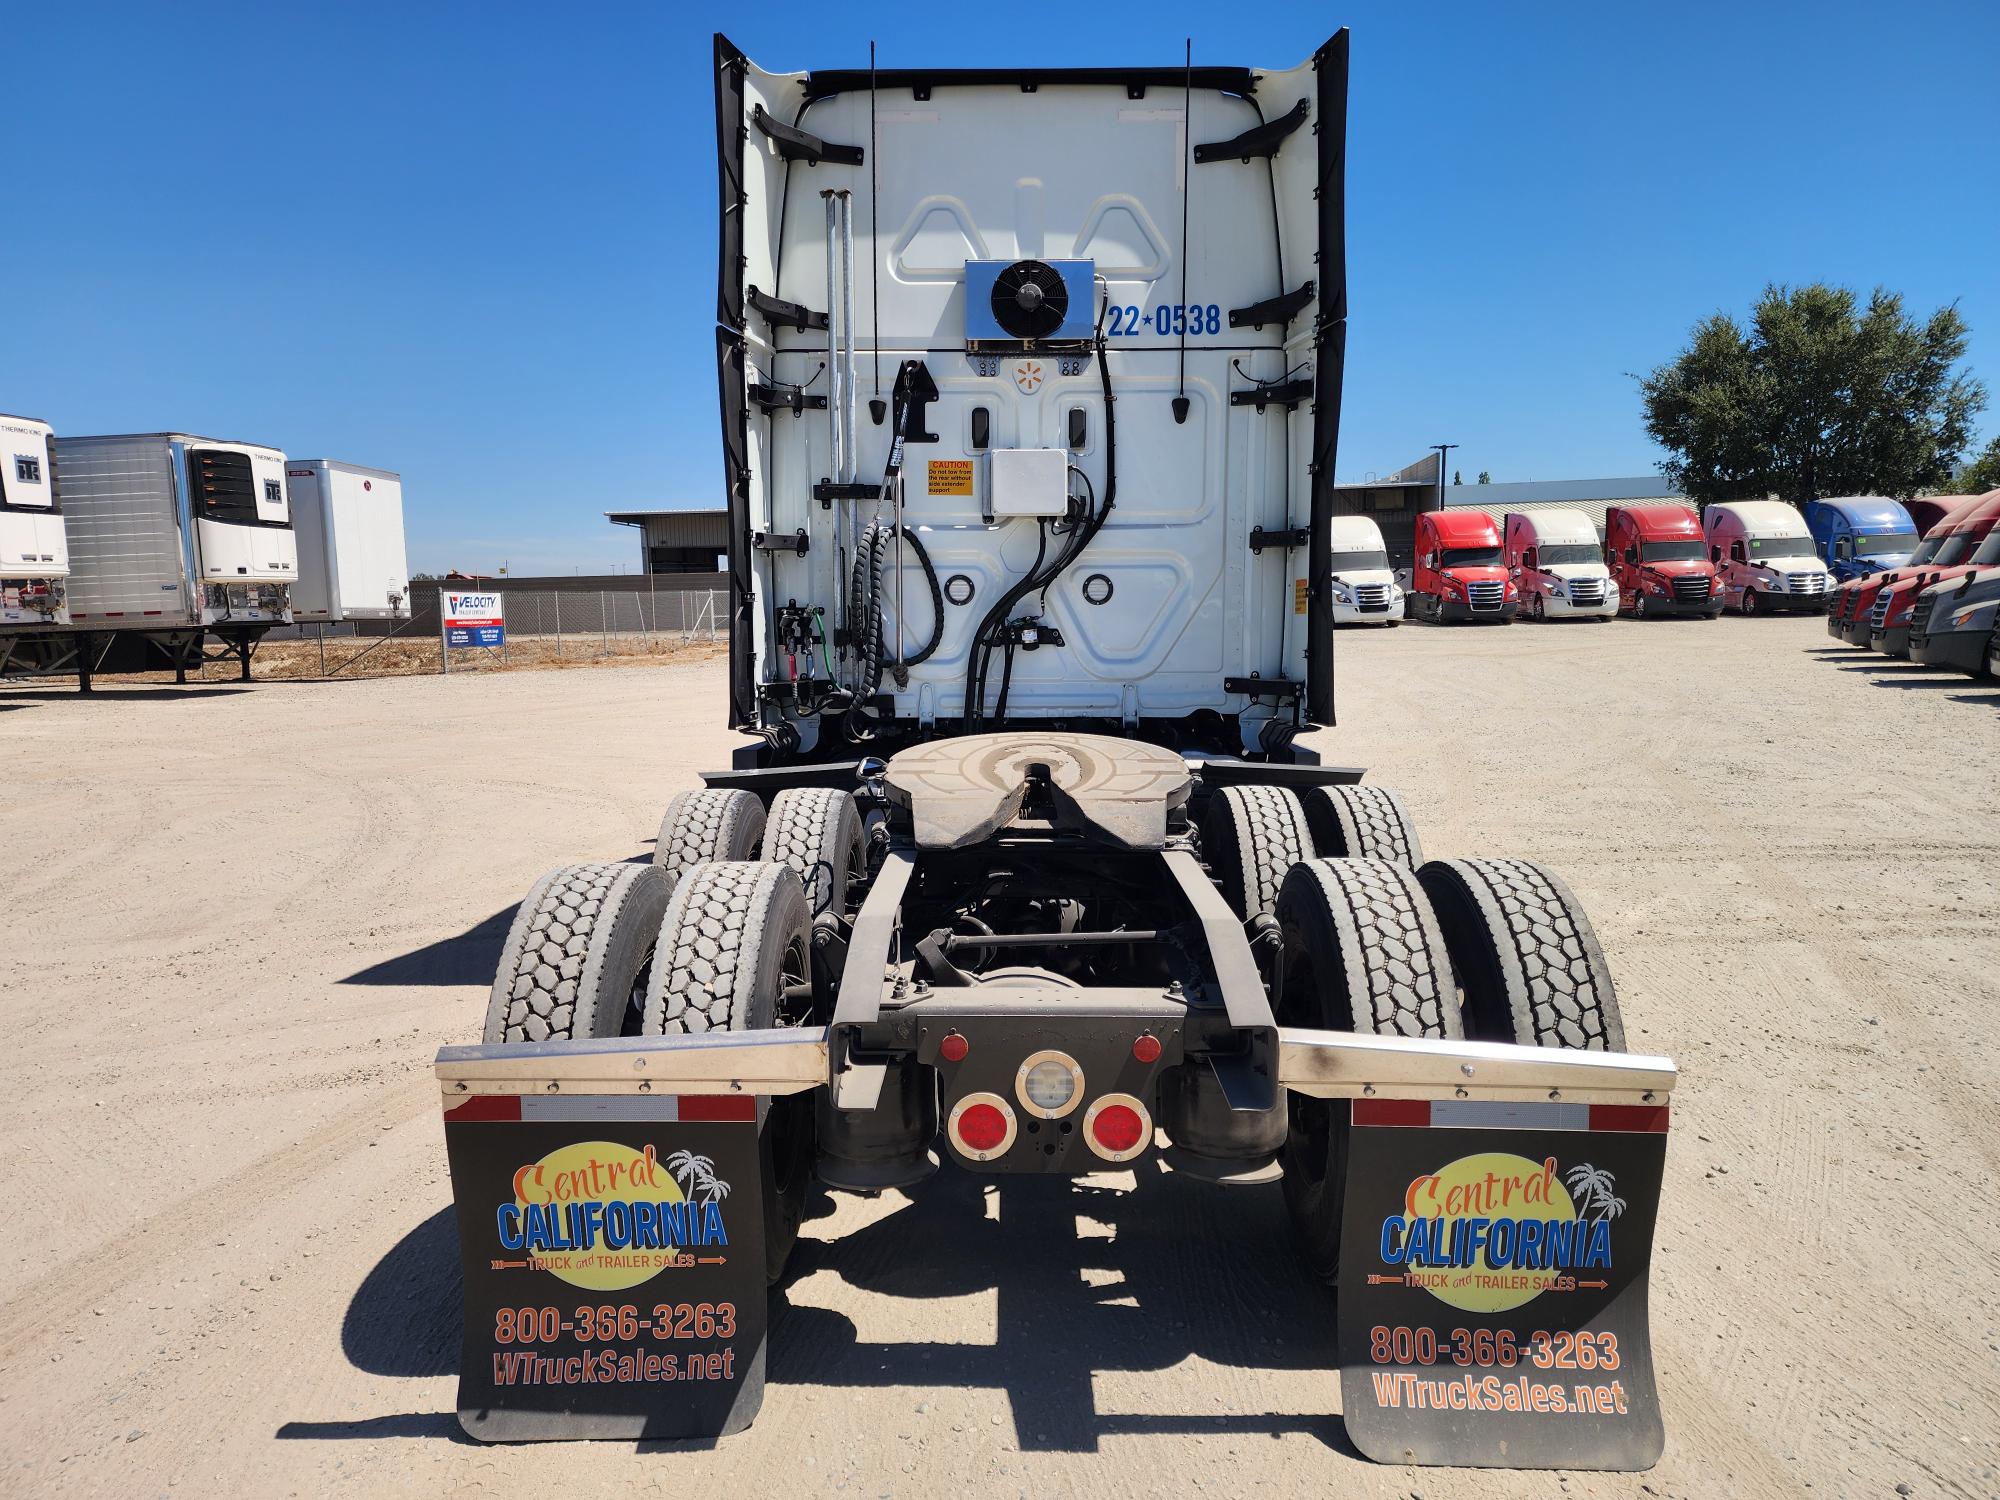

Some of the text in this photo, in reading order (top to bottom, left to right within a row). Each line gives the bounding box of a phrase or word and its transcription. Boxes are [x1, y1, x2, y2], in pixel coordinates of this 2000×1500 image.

[459, 596, 496, 608] VELOCITY
[513, 1144, 663, 1207] Central
[1405, 1156, 1558, 1221] Central
[497, 1201, 729, 1251] CALIFORNIA
[1381, 1215, 1612, 1270] CALIFORNIA
[527, 1253, 696, 1271] TRUCK and TRAILER SALES
[1403, 1272, 1576, 1292] TRUCK and TRAILER SALES
[494, 1302, 736, 1344] 800-366-3263
[493, 1347, 735, 1385] WTruckSales.net
[1370, 1325, 1620, 1370] 800-366-3263
[1372, 1372, 1628, 1414] WTruckSales.net
